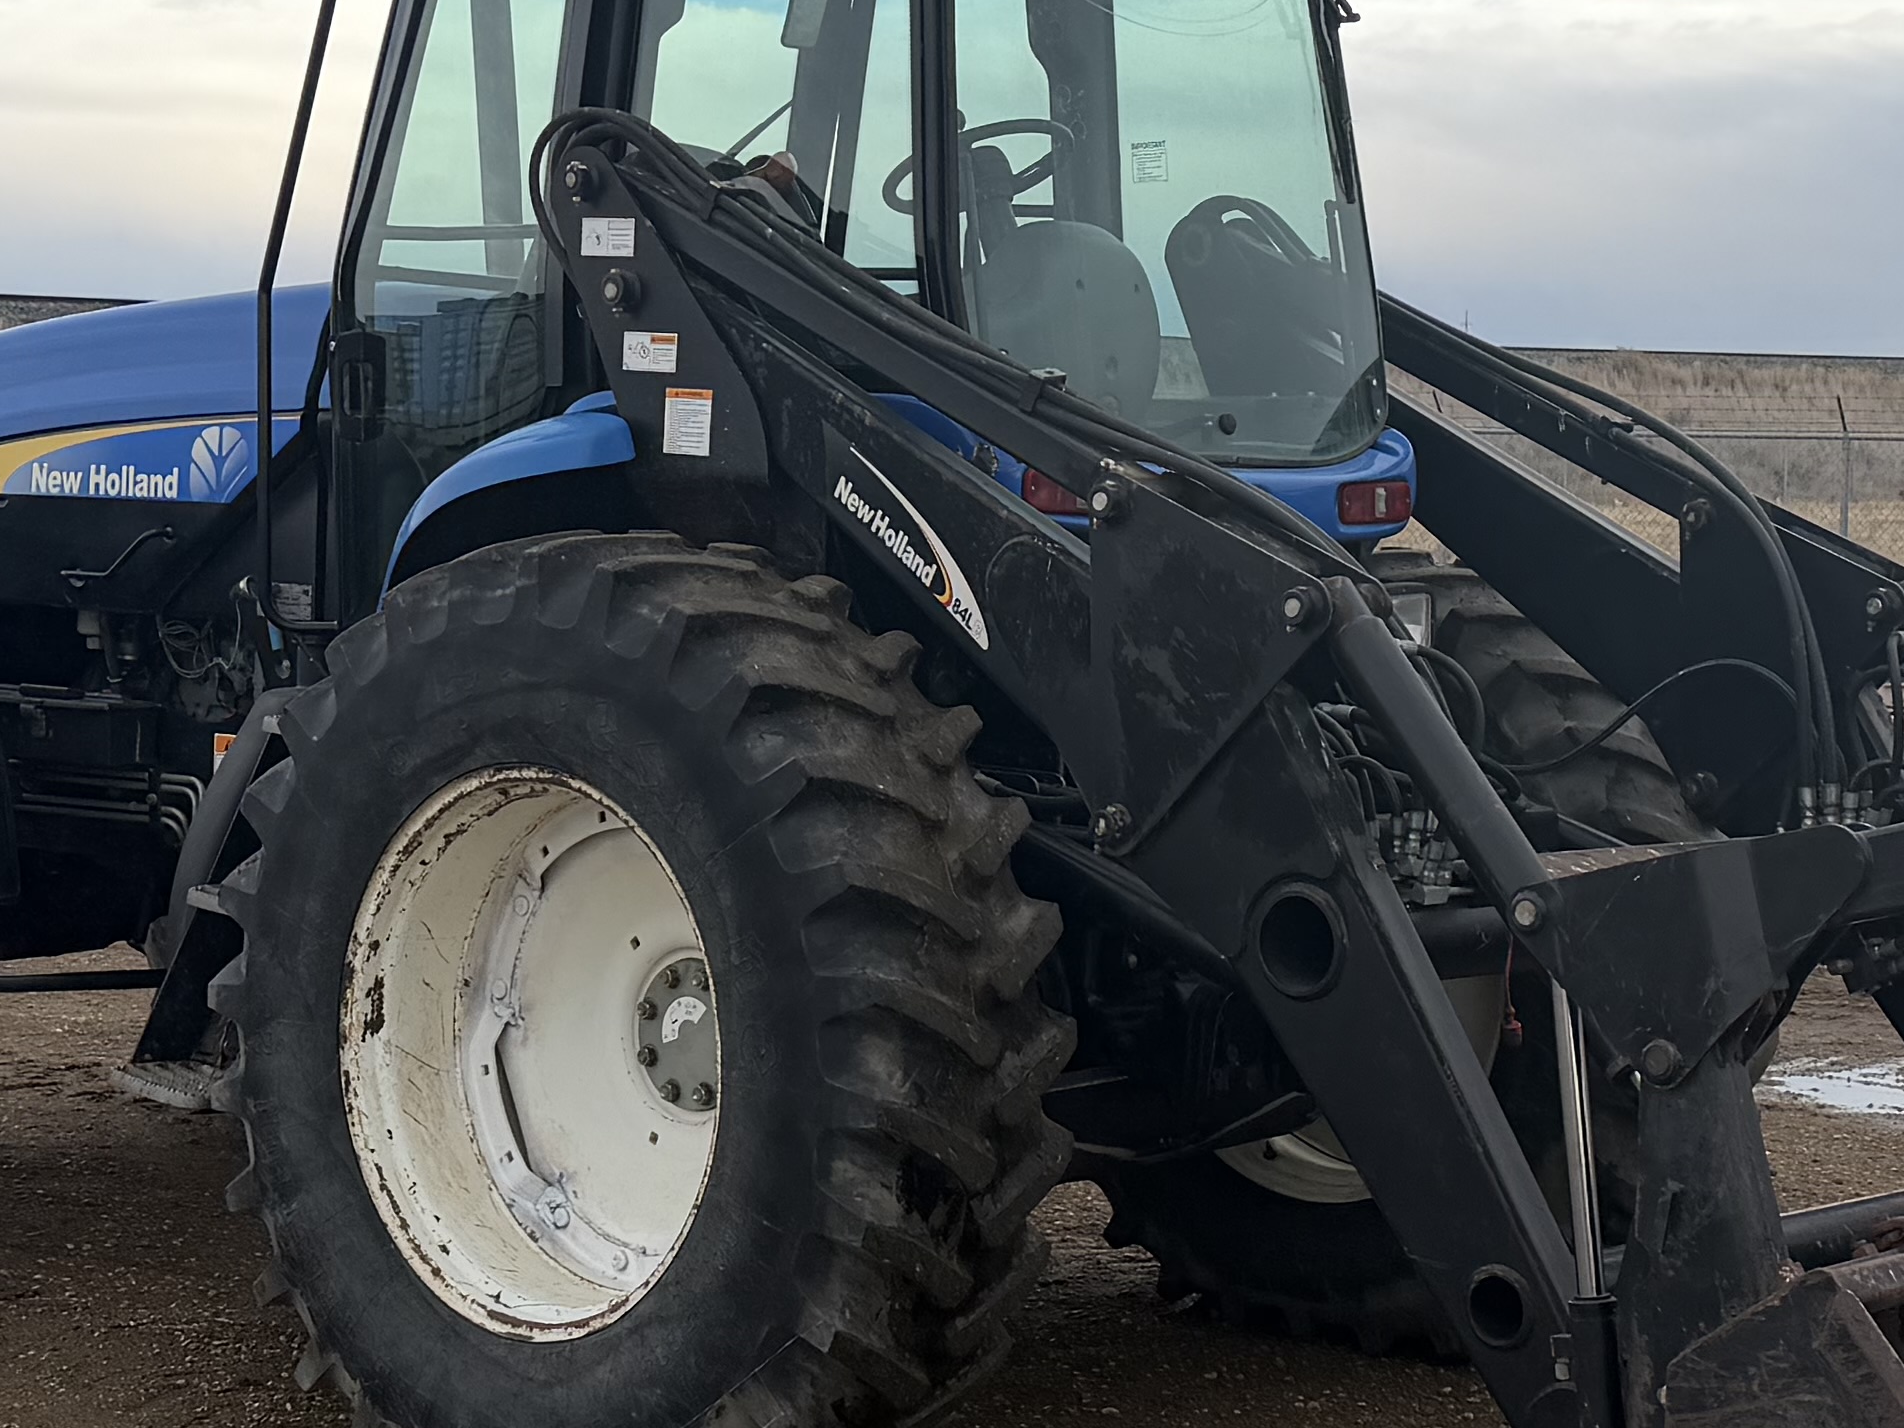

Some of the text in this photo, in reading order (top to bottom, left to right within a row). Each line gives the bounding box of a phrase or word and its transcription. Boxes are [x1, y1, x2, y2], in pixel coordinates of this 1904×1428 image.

[30, 462, 179, 499] New Holland
[834, 475, 938, 588] New Holland
[952, 597, 973, 631] 84L
